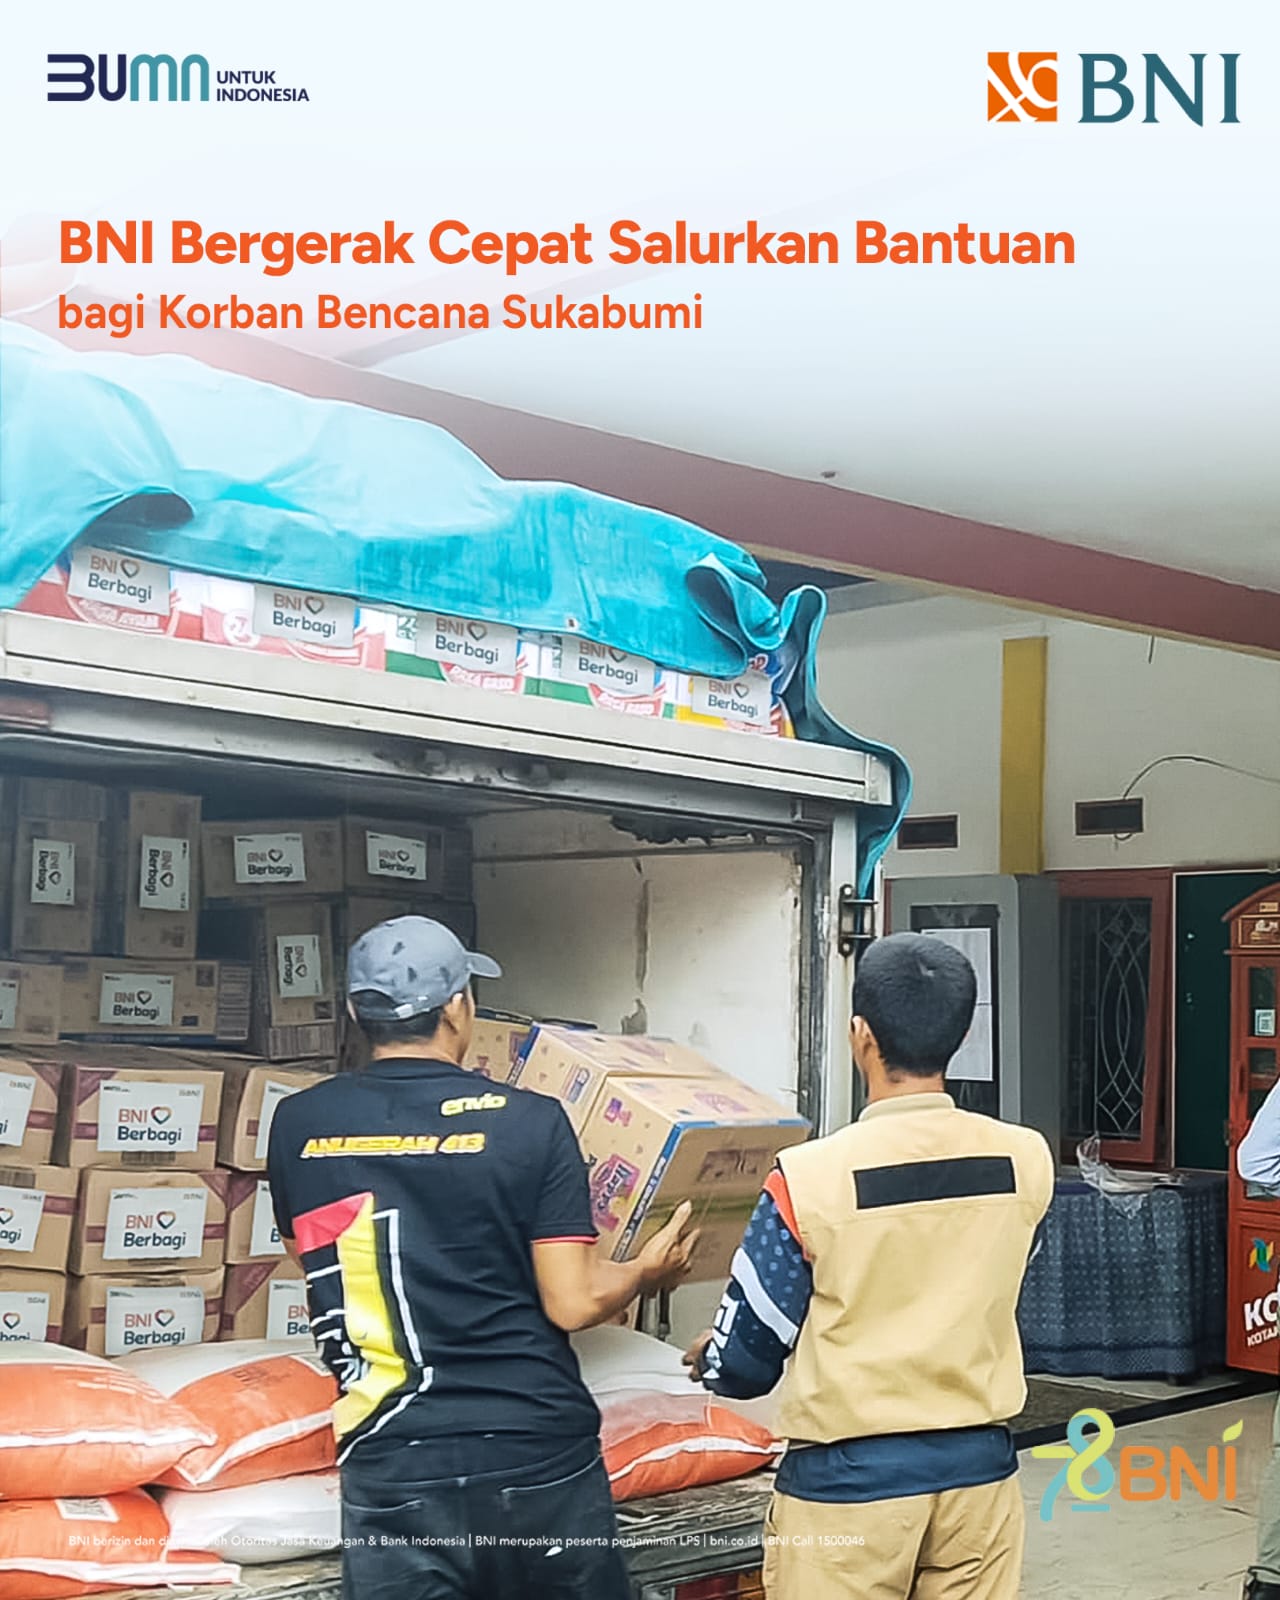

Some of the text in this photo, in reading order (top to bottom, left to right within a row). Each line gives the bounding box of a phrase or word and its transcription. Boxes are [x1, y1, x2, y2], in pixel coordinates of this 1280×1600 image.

[90, 555, 118, 574] BNI
[88, 573, 152, 603] Berbagi
[273, 593, 302, 611] BNI
[272, 611, 336, 638] Berbagi
[436, 617, 464, 636] BNI
[435, 635, 499, 664] Berbagi
[579, 641, 606, 659] BNI
[578, 656, 638, 685] Berbagi
[708, 680, 732, 695] BNI
[708, 694, 759, 718] Berbagi
[113, 1004, 160, 1021] Berbagi
[118, 1108, 148, 1124] BNI
[117, 1126, 183, 1146] Berbagi
[125, 1214, 154, 1229] BNI
[123, 1231, 187, 1251] Berbagi
[124, 1313, 152, 1328] BNI
[123, 1327, 186, 1346] Berbagi
